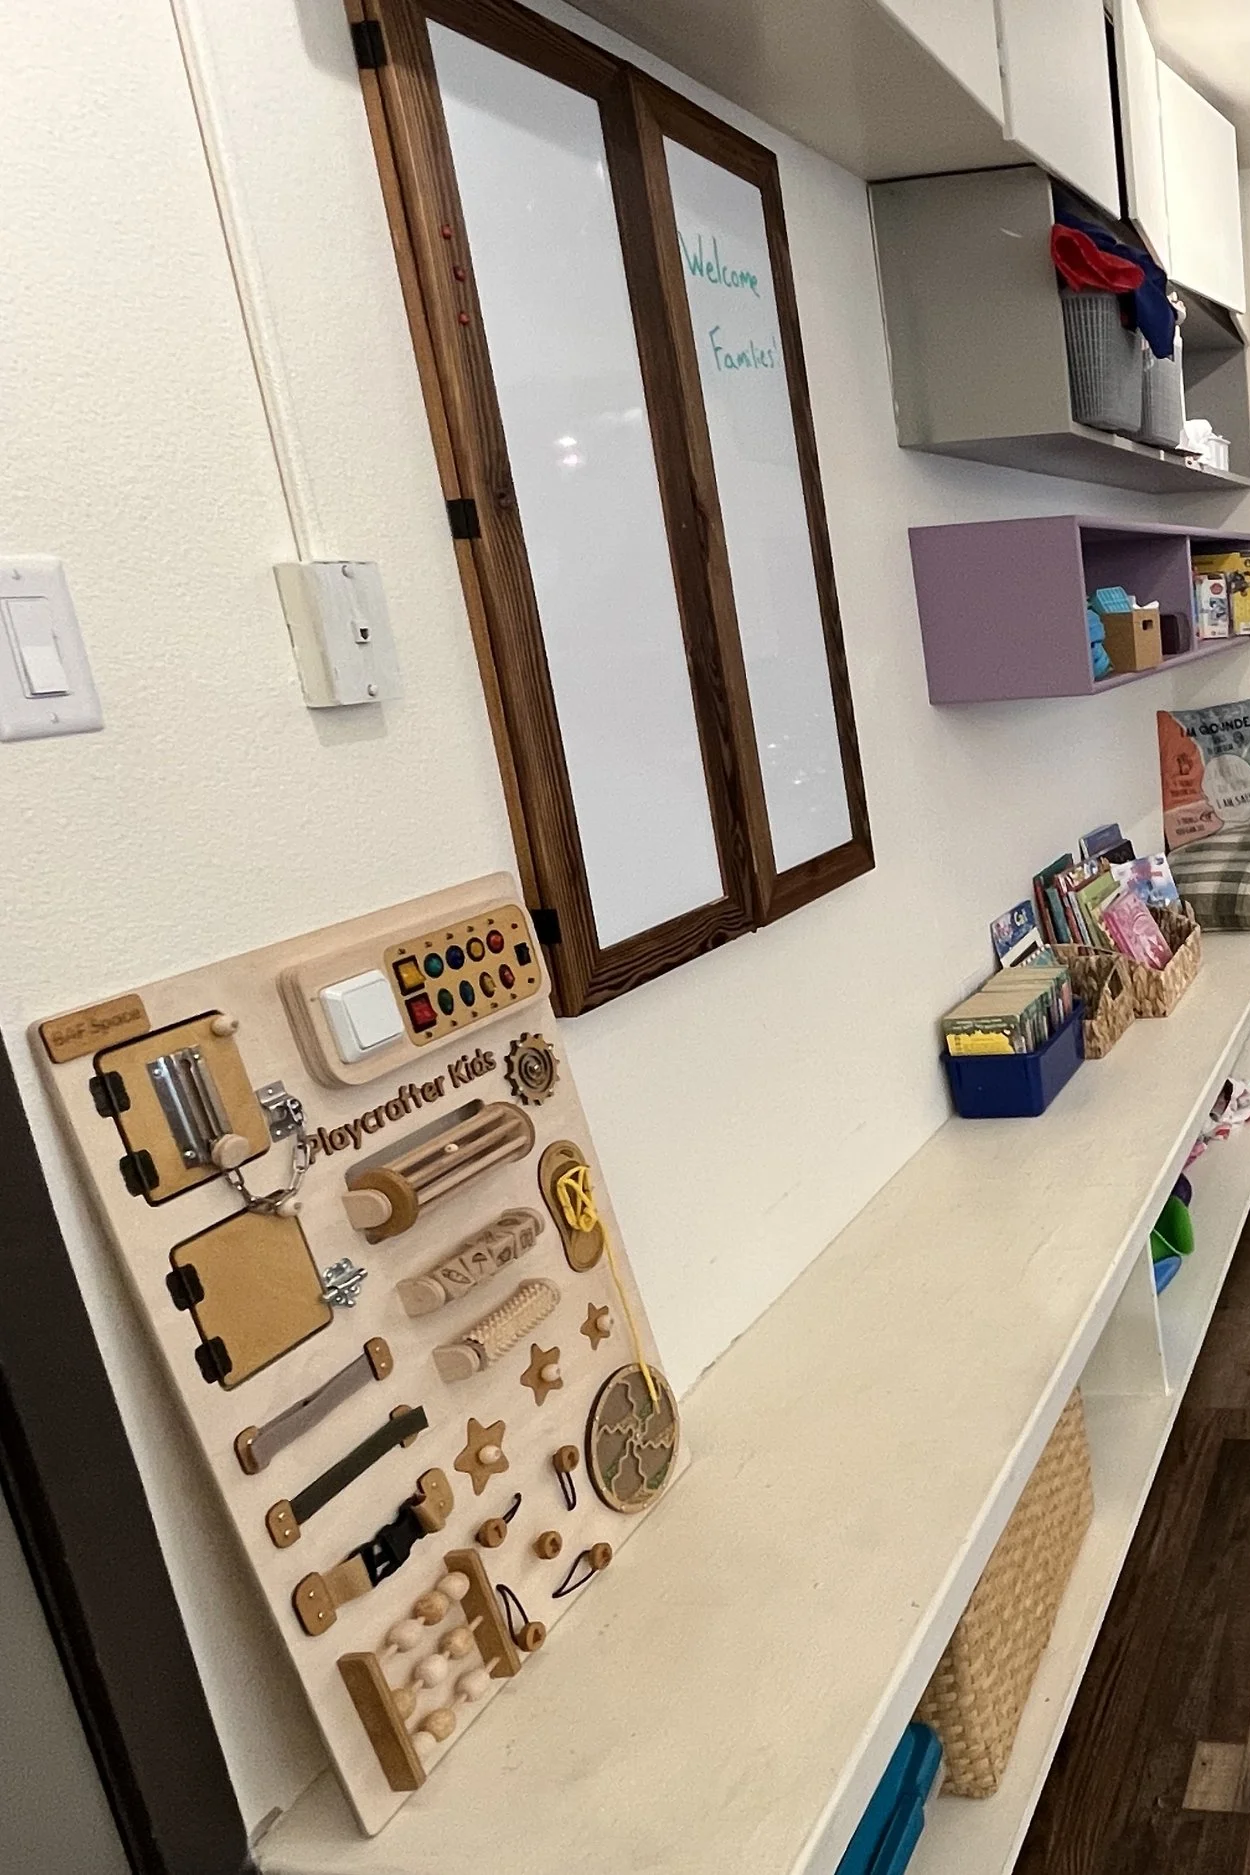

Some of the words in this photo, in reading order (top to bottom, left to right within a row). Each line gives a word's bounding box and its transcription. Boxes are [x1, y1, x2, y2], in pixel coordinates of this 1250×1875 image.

[677, 231, 760, 298] Welcome
[304, 1075, 446, 1165] Playcrafter
[447, 1048, 497, 1089] Kids
